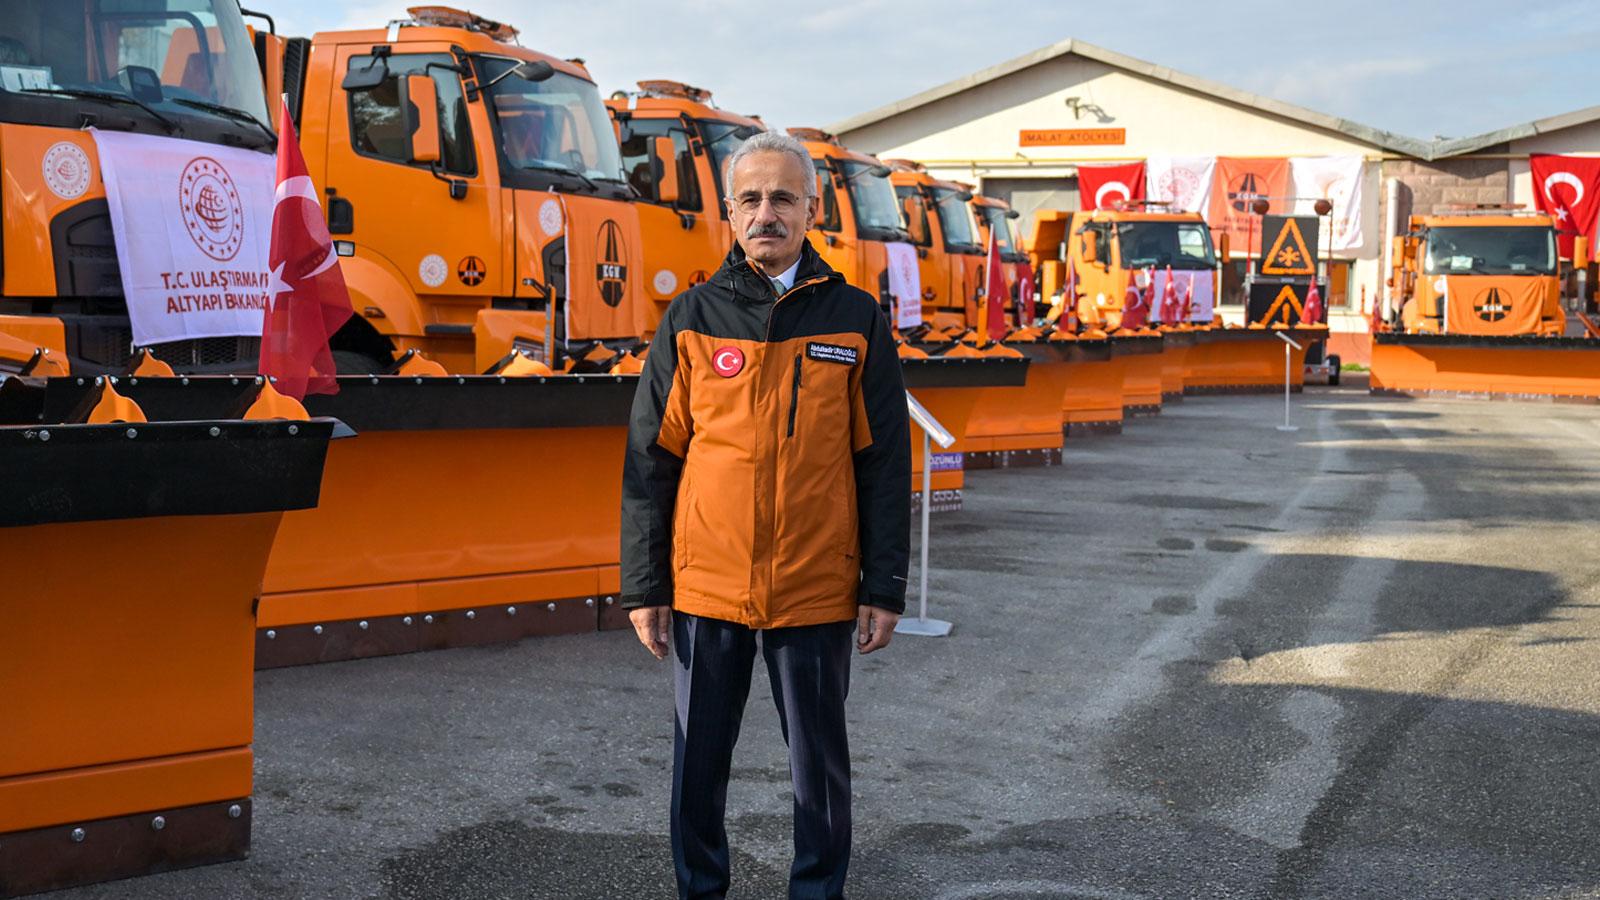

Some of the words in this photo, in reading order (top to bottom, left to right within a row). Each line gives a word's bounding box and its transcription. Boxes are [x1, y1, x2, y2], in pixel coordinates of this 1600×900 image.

[160, 271, 189, 290] T.C.
[191, 270, 258, 291] ULAŞTIRMA
[167, 293, 223, 314] ALTYAPI
